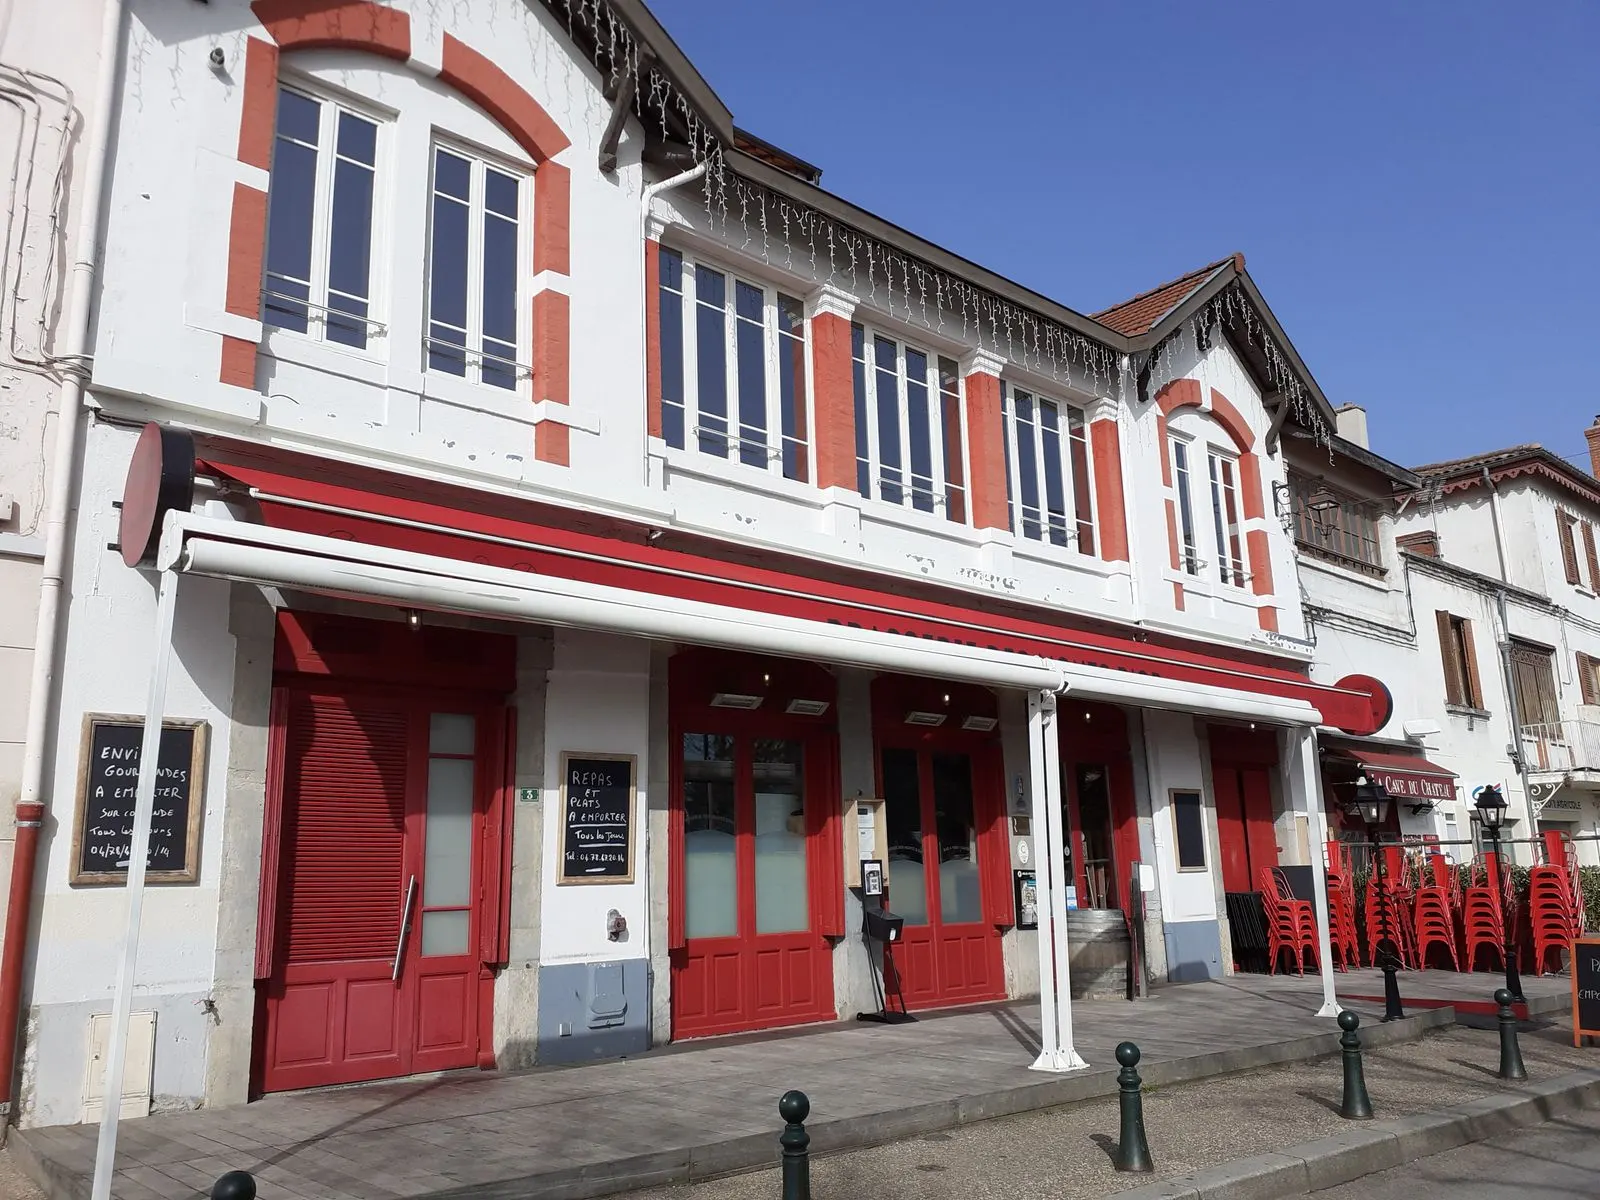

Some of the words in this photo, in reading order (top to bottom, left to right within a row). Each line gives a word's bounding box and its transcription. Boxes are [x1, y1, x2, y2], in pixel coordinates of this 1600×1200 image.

[105, 764, 187, 782] GOURNDES
[572, 770, 613, 786] REPAS
[1385, 776, 1406, 794] CAVE
[1408, 780, 1419, 795] DU
[95, 785, 104, 798] A
[114, 787, 183, 800] EMTER
[585, 789, 600, 797] ET
[570, 797, 600, 809] PLATS
[100, 808, 120, 818] SUR
[569, 811, 576, 822] A
[581, 812, 626, 823] EMPORTER
